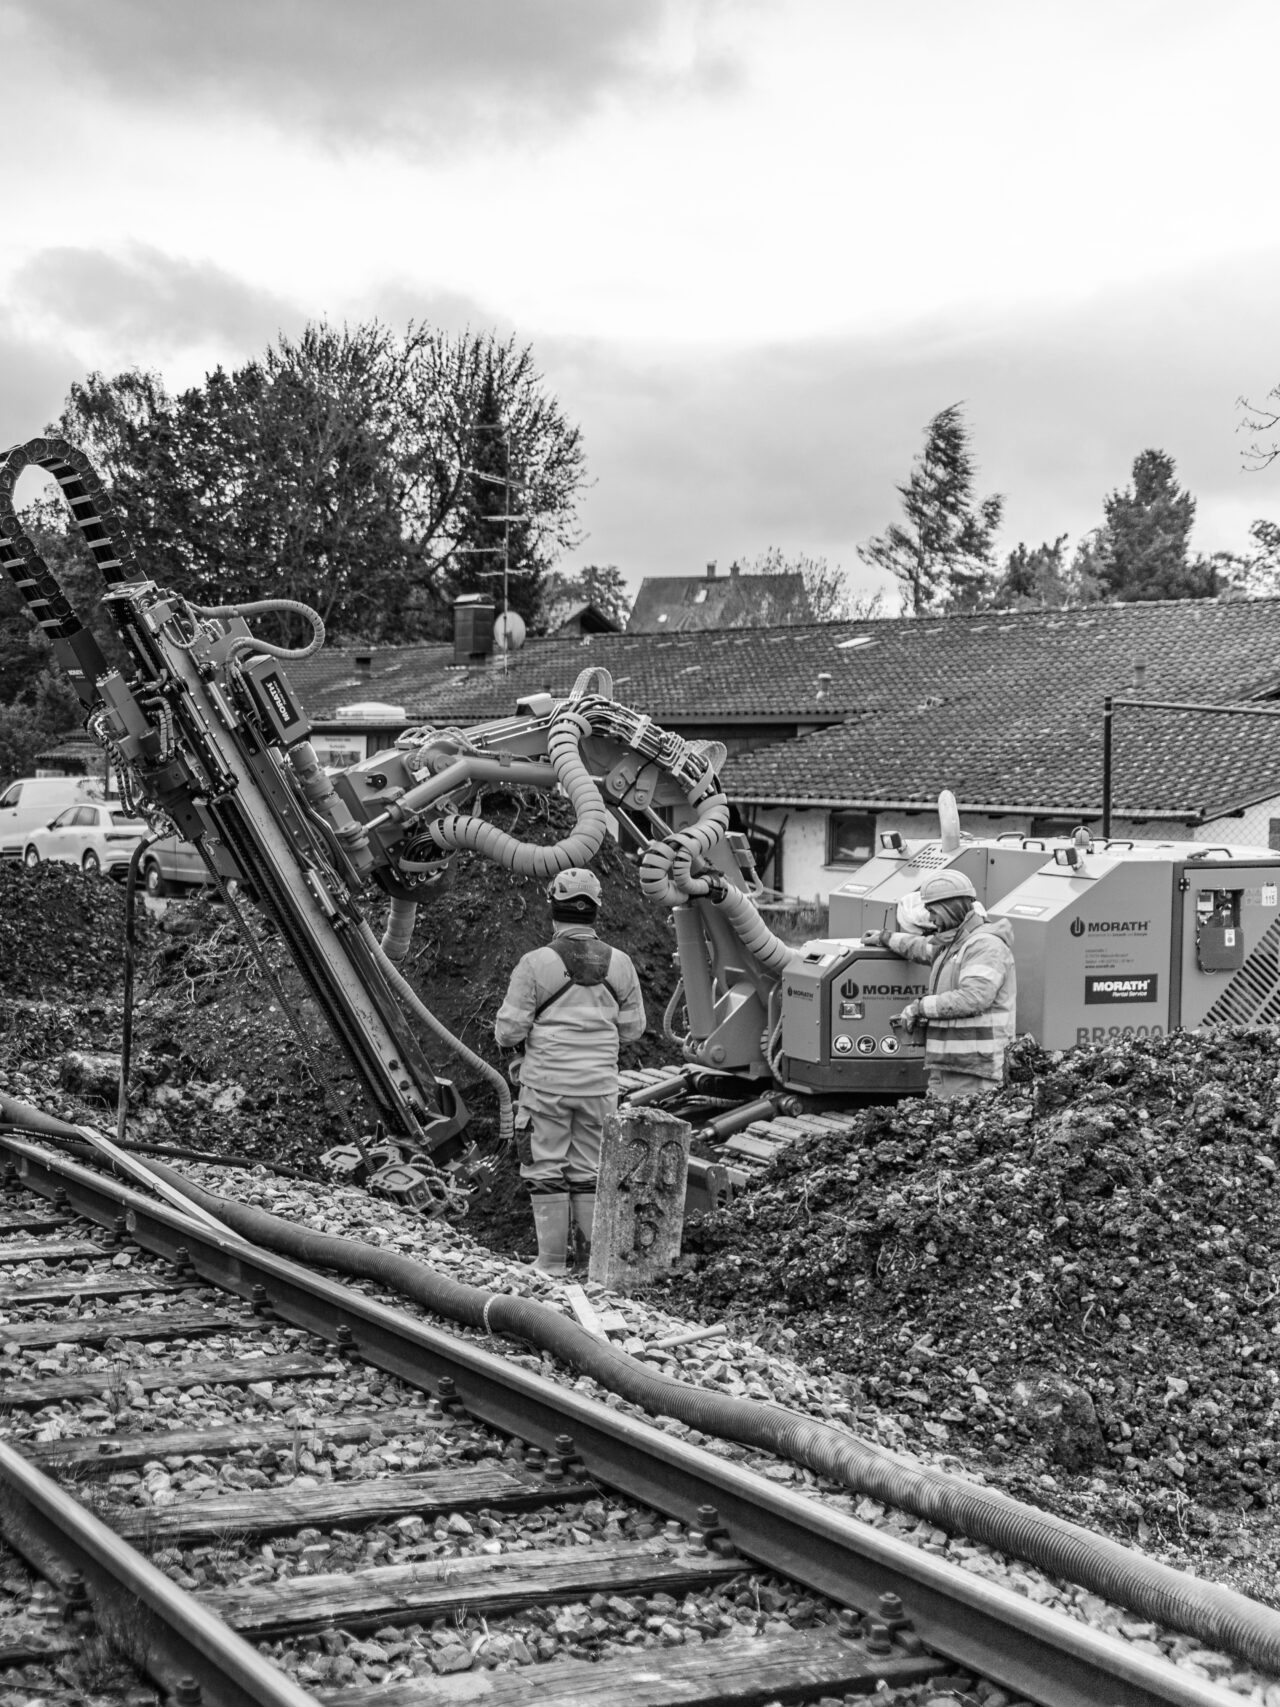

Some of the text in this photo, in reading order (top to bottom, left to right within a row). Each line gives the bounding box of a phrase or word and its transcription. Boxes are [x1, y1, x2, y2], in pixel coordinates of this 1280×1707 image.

[266, 682, 290, 722] MORATH
[1087, 921, 1149, 932] MORATH
[1092, 980, 1149, 992] MORATH
[618, 1138, 684, 1191] 20
